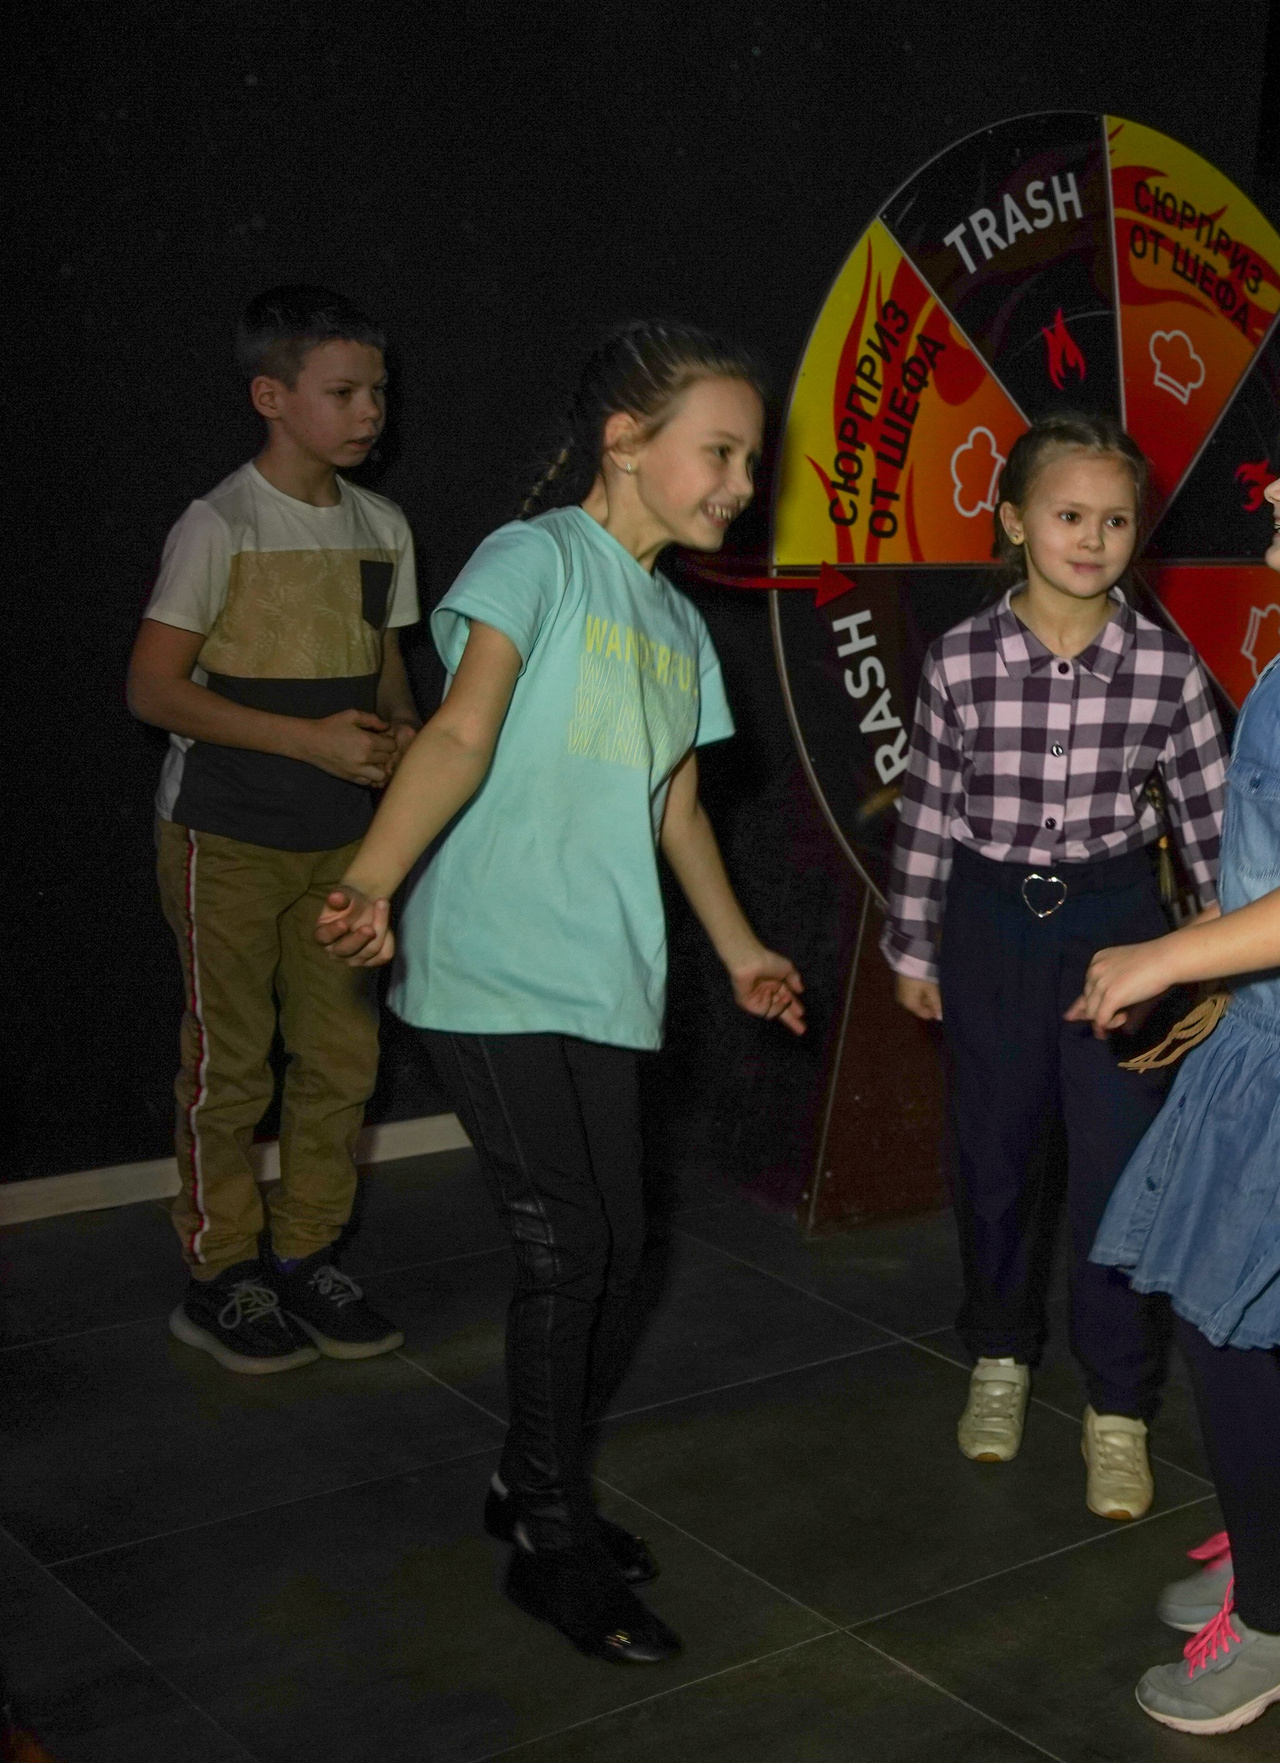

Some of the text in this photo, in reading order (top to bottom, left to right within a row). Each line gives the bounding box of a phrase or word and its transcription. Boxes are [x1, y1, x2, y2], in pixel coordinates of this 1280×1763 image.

[942, 171, 1084, 275] TRASH
[1130, 224, 1249, 334] ОТ ШЕФА
[1134, 180, 1263, 294] СЮРПРИЗ
[828, 299, 910, 528] СЮРПРИЗ
[868, 332, 947, 539] ОТ ШЕФА
[831, 608, 911, 786] RASH
